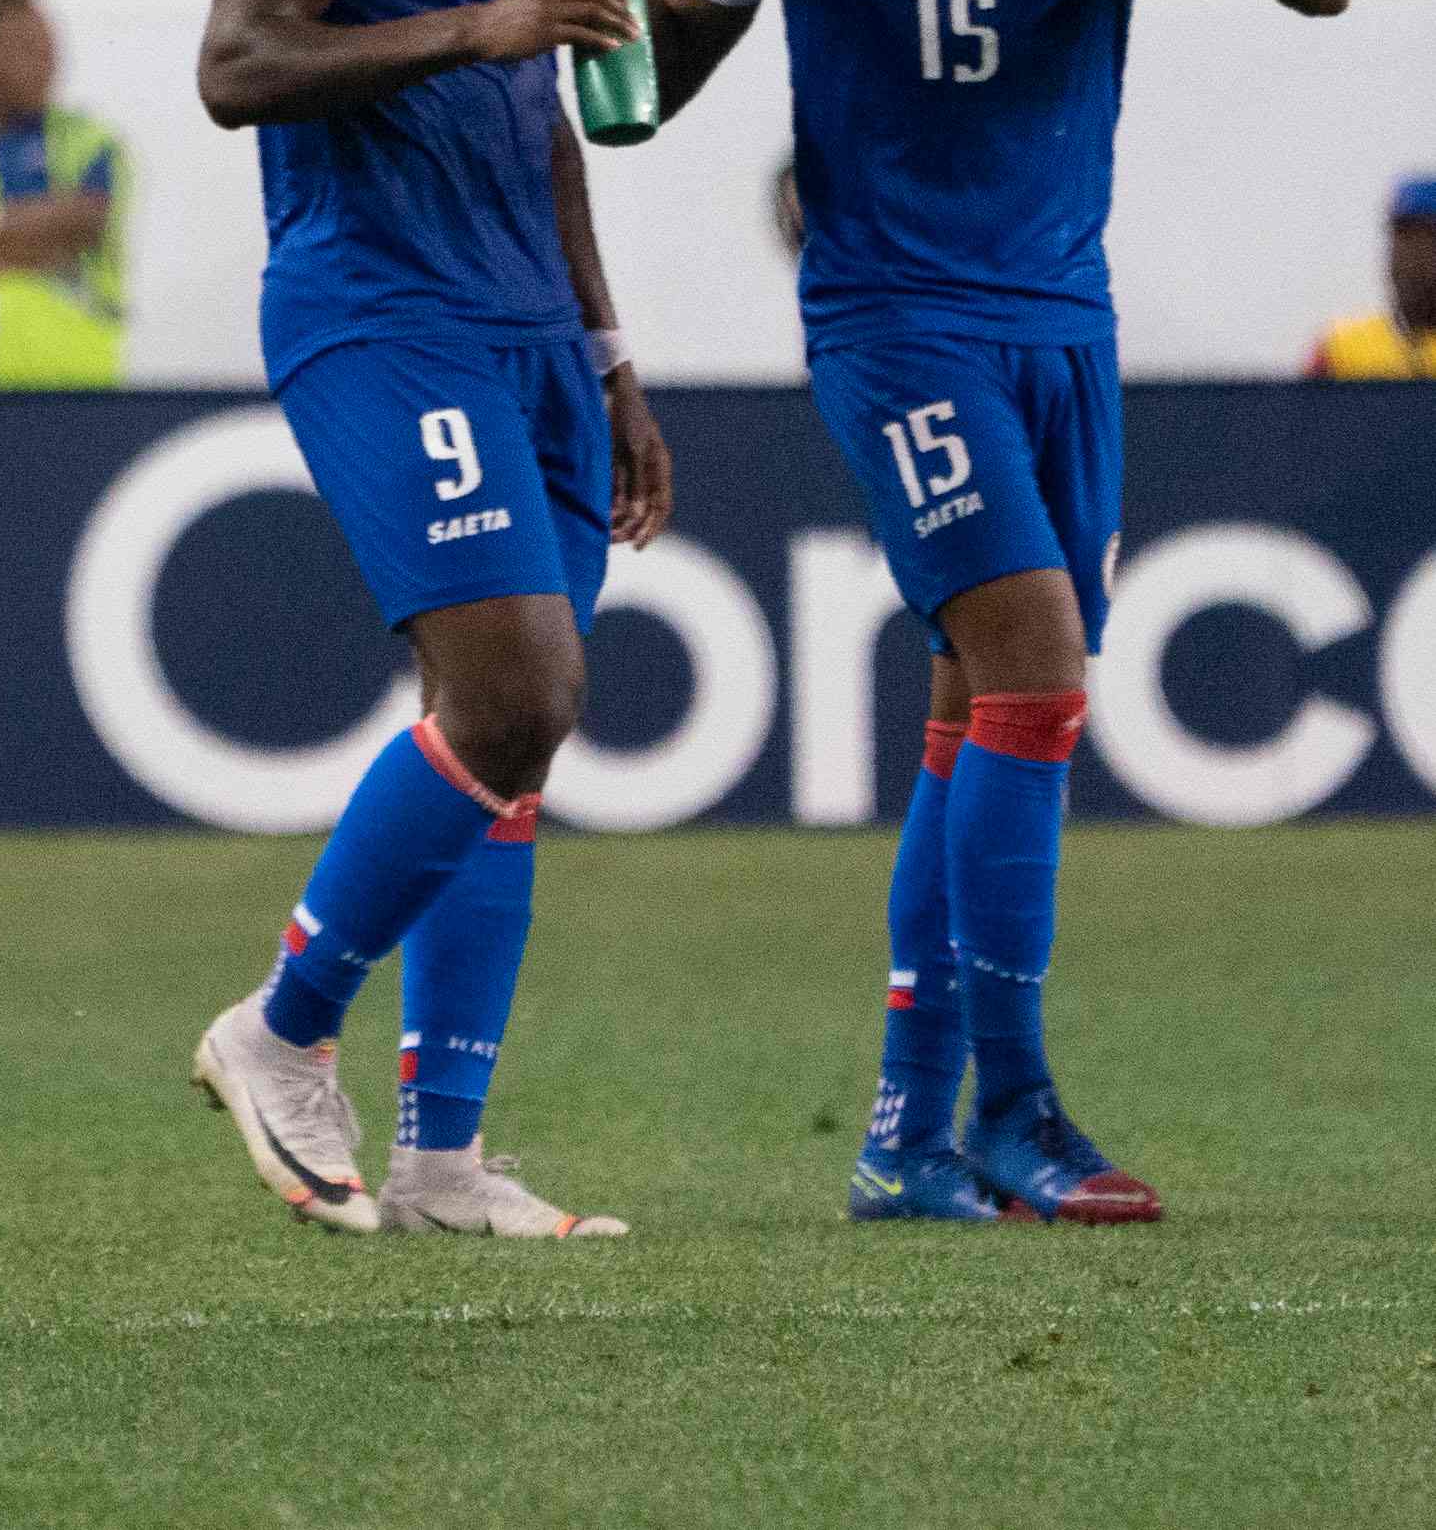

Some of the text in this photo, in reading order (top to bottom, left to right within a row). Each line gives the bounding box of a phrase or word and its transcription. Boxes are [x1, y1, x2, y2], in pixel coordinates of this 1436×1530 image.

[420, 408, 482, 501] 9
[882, 399, 972, 508] 15
[427, 508, 511, 545] SAETA
[913, 491, 985, 539] SAETA
